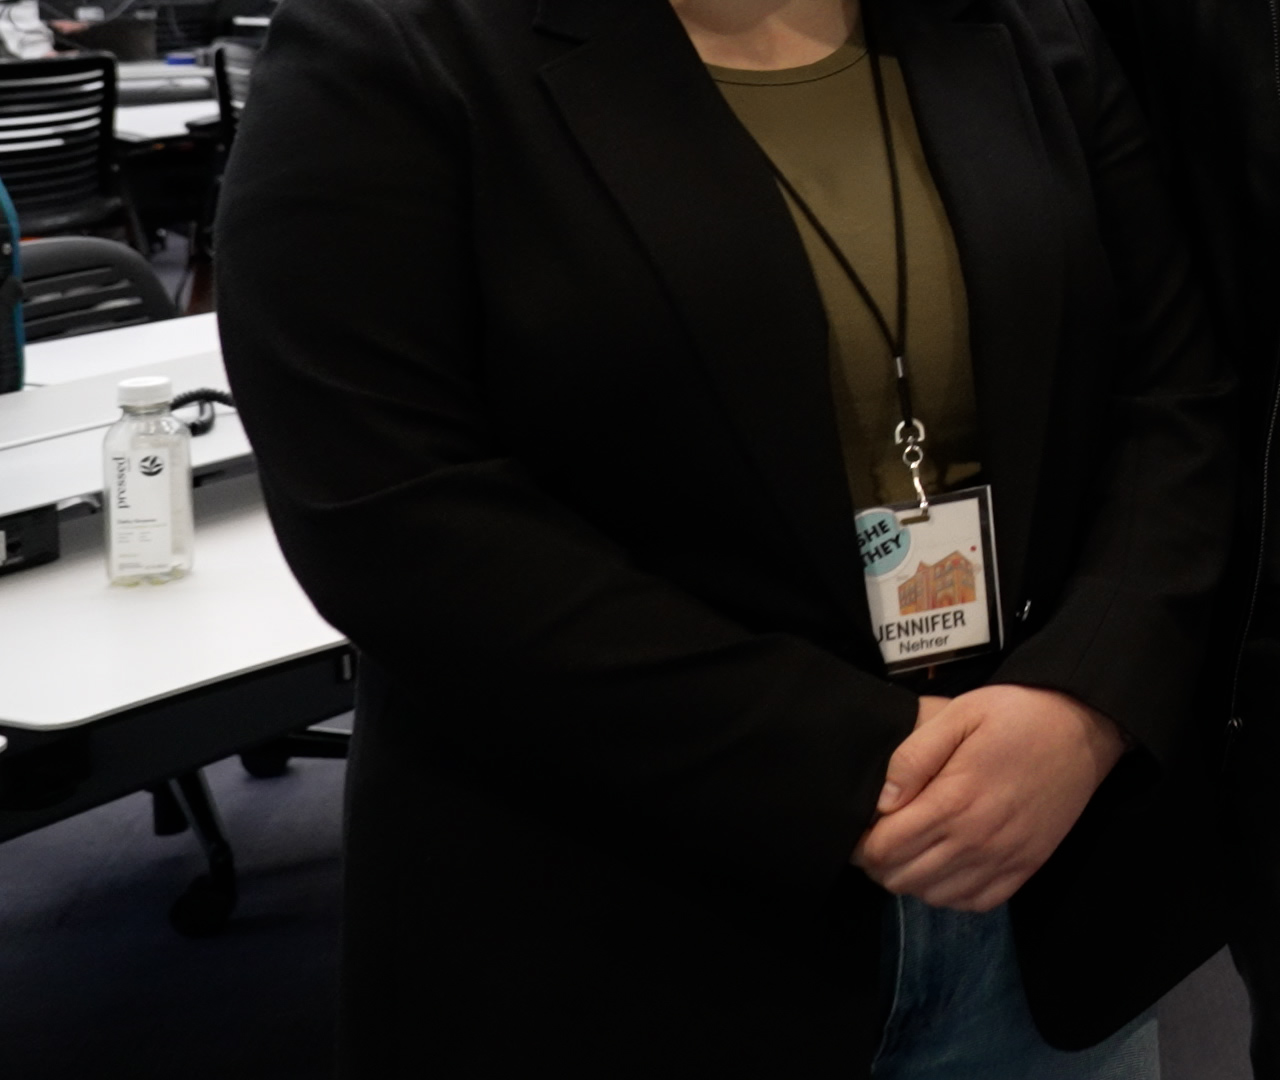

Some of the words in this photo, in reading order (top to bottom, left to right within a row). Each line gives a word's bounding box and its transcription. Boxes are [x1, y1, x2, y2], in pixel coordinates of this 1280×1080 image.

[856, 519, 890, 547] SHE
[878, 610, 966, 643] JENNIFER
[899, 634, 949, 655] Nehrer
